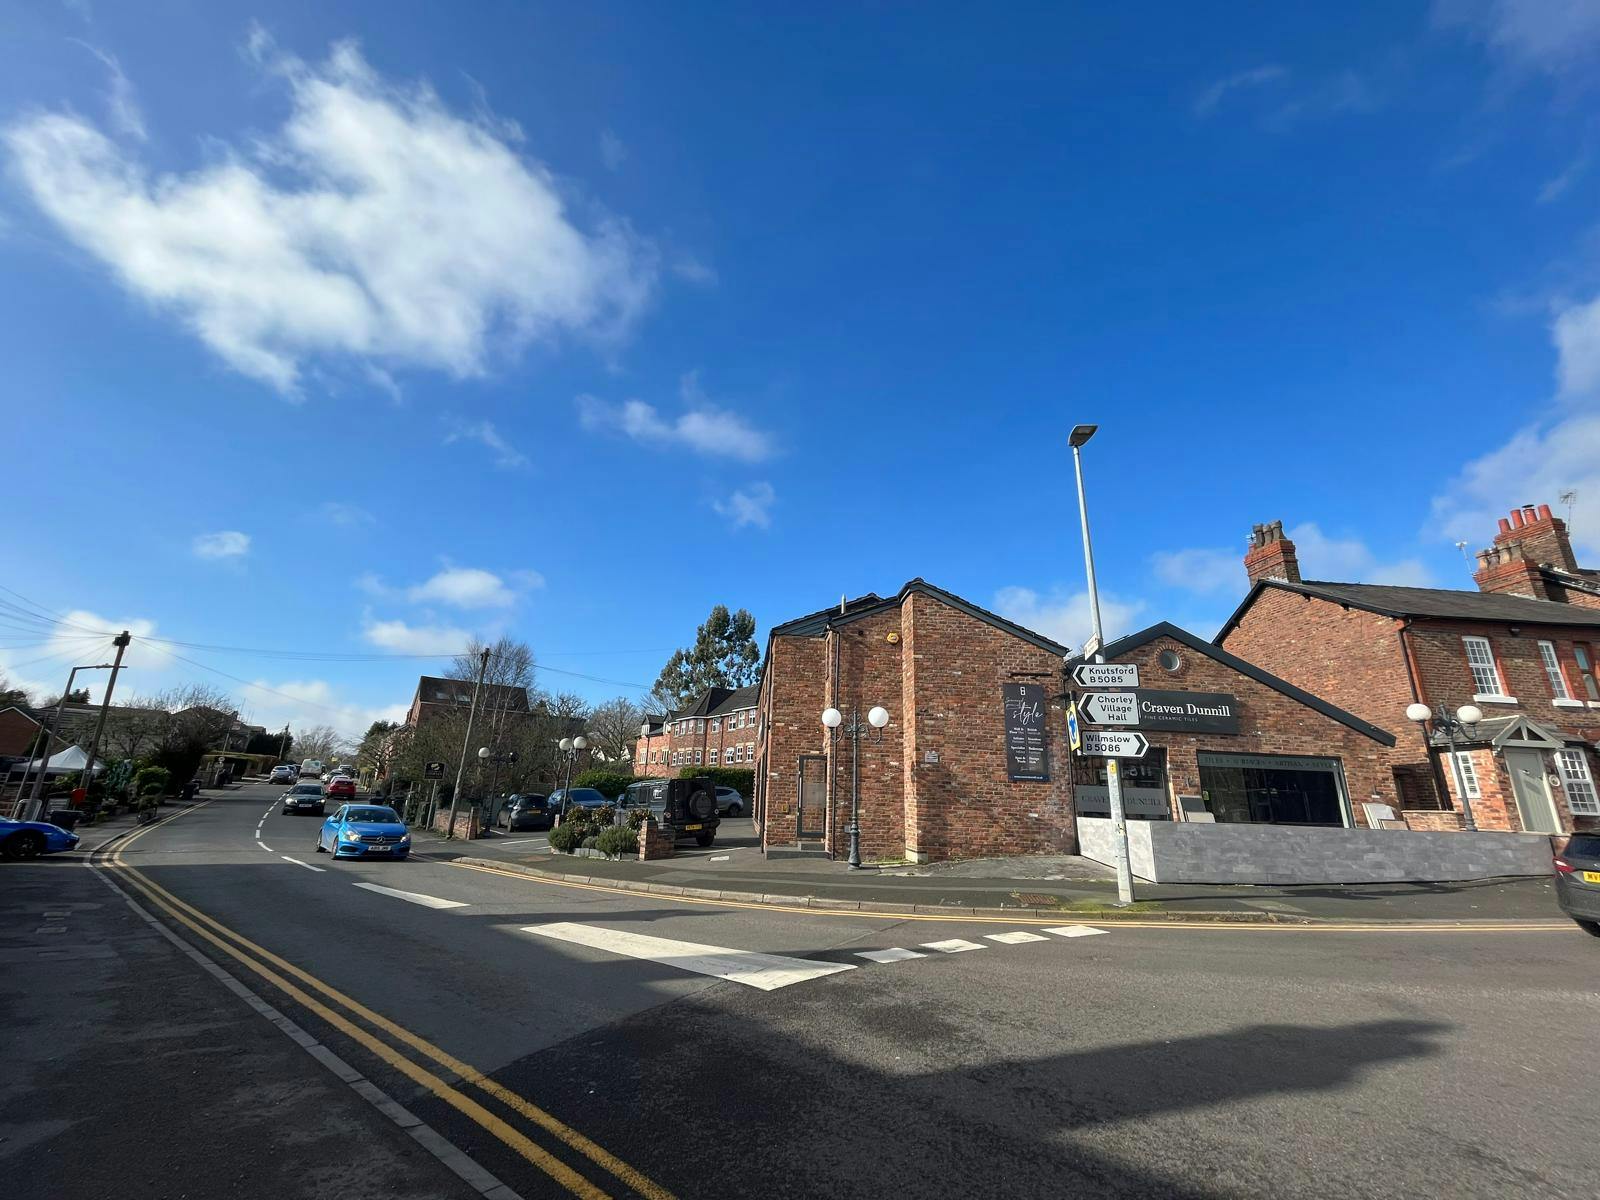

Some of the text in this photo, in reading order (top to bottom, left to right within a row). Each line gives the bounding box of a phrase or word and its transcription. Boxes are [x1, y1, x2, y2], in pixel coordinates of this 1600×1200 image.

[1088, 667, 1134, 675] Knutsford
[1097, 695, 1133, 704] Chorley
[1100, 704, 1132, 713] Village
[1141, 701, 1231, 717] Craven Dunnill
[1085, 734, 1131, 743] Wilmslow
[1094, 744, 1121, 752] 5086
[1081, 794, 1110, 804] CRAVE
